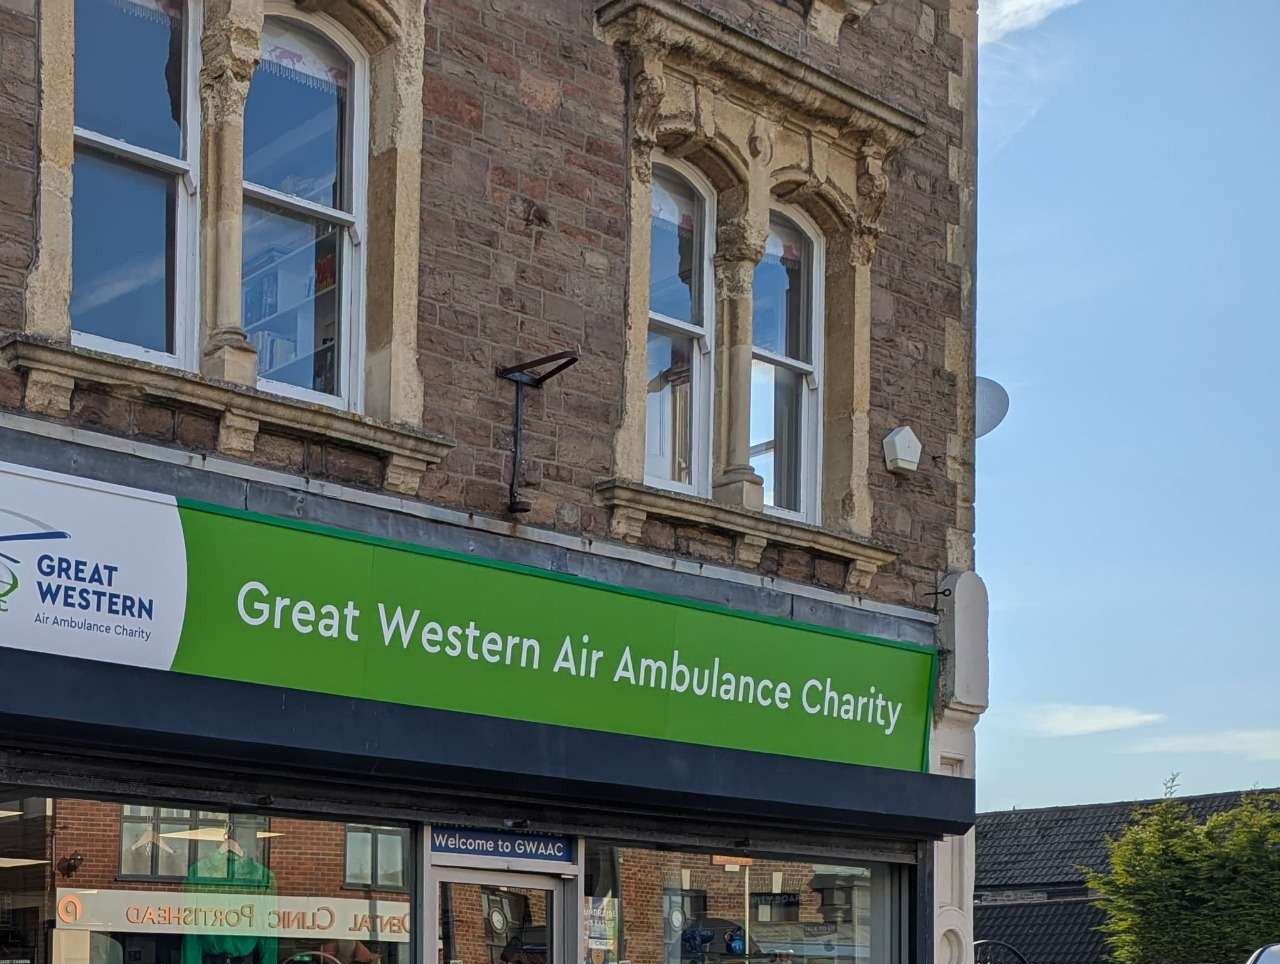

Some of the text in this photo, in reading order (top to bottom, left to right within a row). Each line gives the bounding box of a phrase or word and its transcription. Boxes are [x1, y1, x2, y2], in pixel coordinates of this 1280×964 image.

[36, 554, 118, 588] GREAT
[35, 581, 154, 621] WESTERN
[34, 612, 152, 642] Air Ambulance Charity
[236, 580, 903, 736] Great Western Air Ambulance Charity
[433, 832, 565, 857] Welcome to GWAAC
